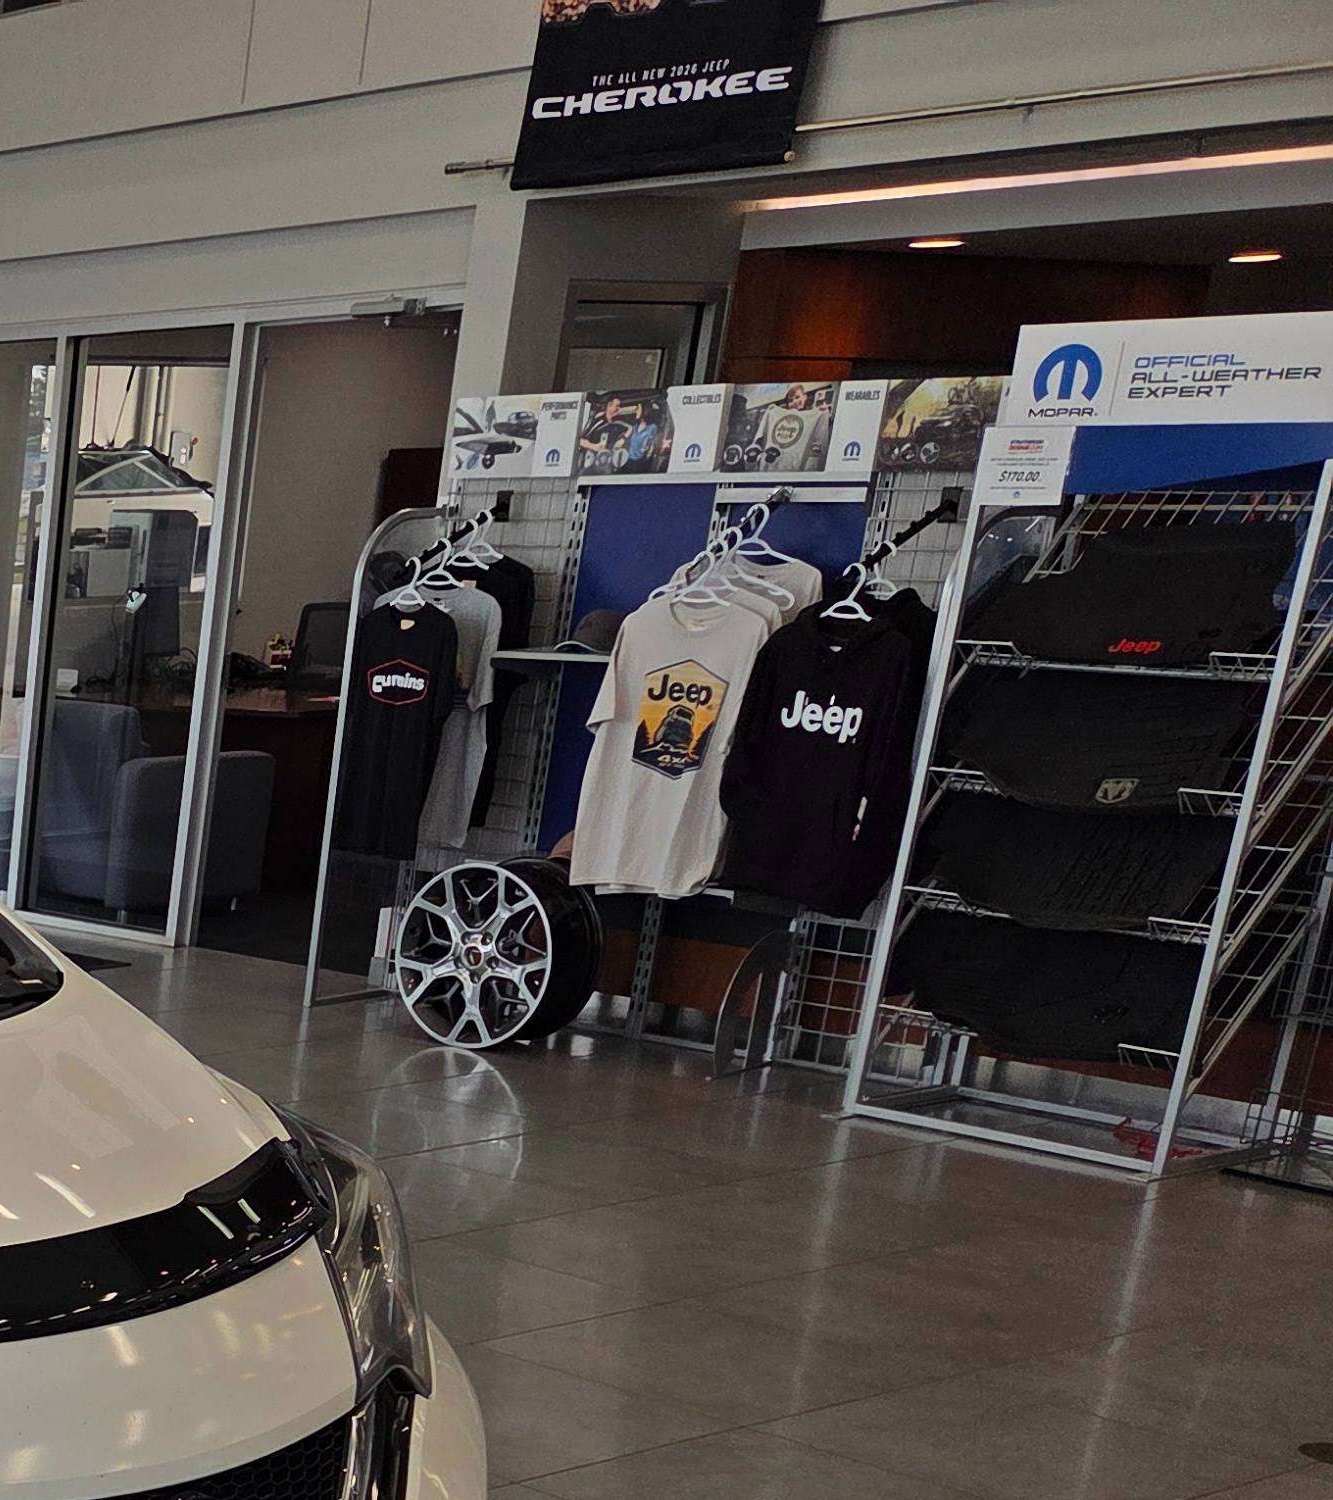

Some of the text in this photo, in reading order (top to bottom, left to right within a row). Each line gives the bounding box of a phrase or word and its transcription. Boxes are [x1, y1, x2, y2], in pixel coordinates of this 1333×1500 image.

[592, 58, 730, 87] THE ALL NEW 2026 JEEP
[531, 66, 793, 120] CHEROKEE
[1134, 354, 1247, 369] OFFICIAL
[1130, 366, 1323, 385] ALL-WEATHER
[845, 389, 882, 402] WEARABLES
[1127, 384, 1234, 400] EXPERT
[1027, 407, 1096, 419] MOPAR
[998, 470, 1041, 482] $170.00
[1108, 638, 1162, 654] Jeep
[648, 673, 713, 709] Jeep
[781, 690, 863, 744] Jeep
